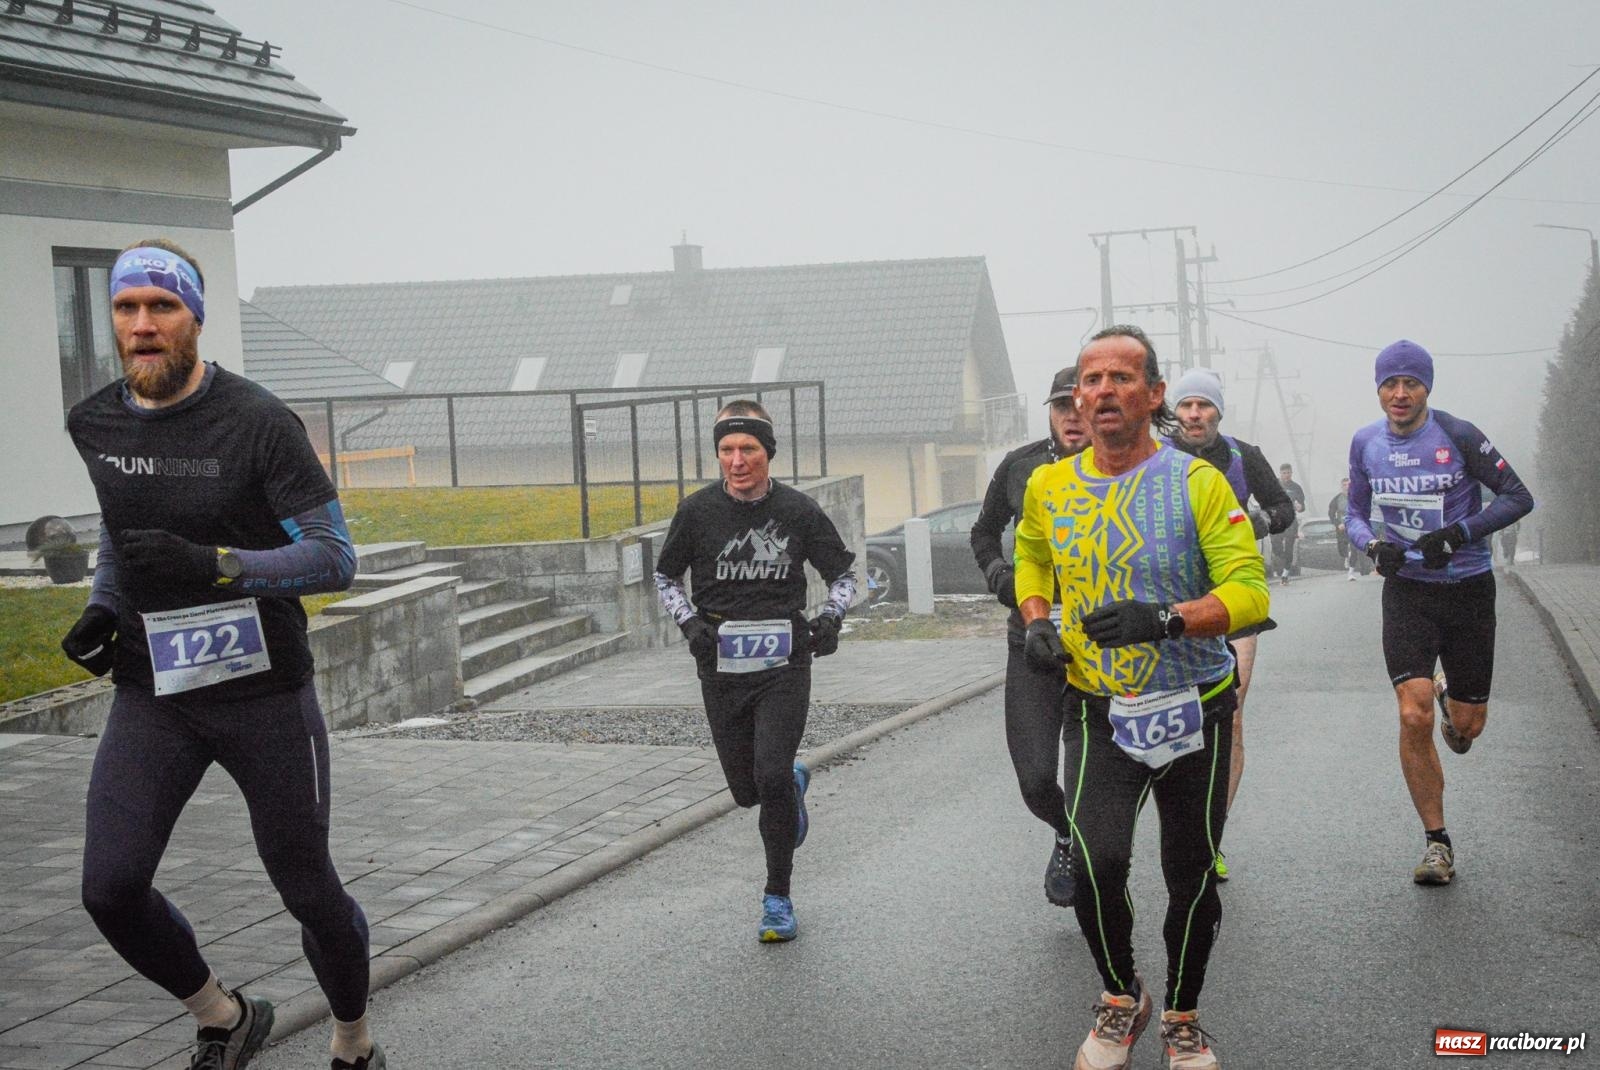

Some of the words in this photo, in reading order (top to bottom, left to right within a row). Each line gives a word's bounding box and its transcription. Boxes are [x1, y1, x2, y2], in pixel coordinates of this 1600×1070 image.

[1152, 474, 1167, 539] BIEGAJA
[1398, 508, 1424, 529] 16
[716, 559, 790, 580] DYNAFIT
[169, 624, 245, 667] 122
[731, 635, 779, 658] 179
[1125, 707, 1185, 748] 165
